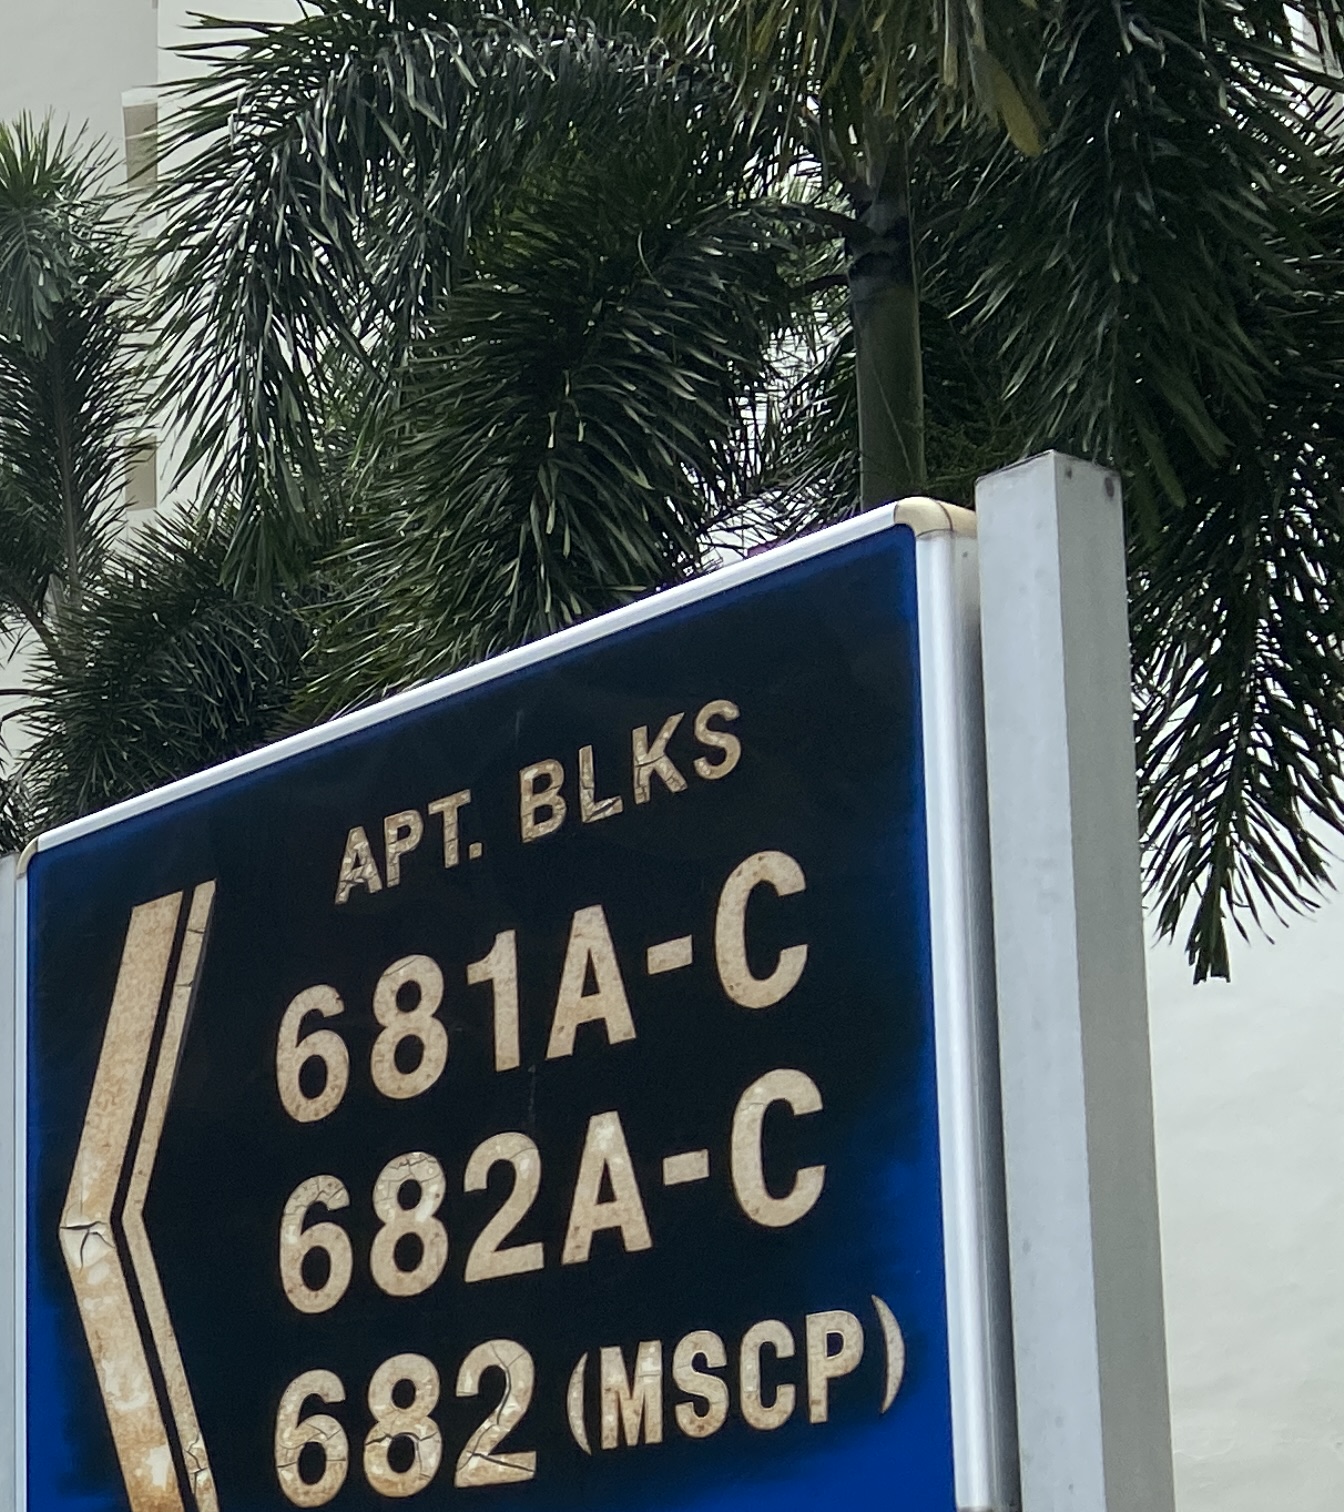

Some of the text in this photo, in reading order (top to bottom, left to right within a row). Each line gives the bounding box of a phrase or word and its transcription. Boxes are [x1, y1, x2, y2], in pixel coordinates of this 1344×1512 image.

[334, 699, 742, 904] APT. BLKS
[275, 850, 809, 1124] 681A-C
[278, 1068, 827, 1314] 682A-C
[273, 1295, 905, 1509] 682 (MSCP)
